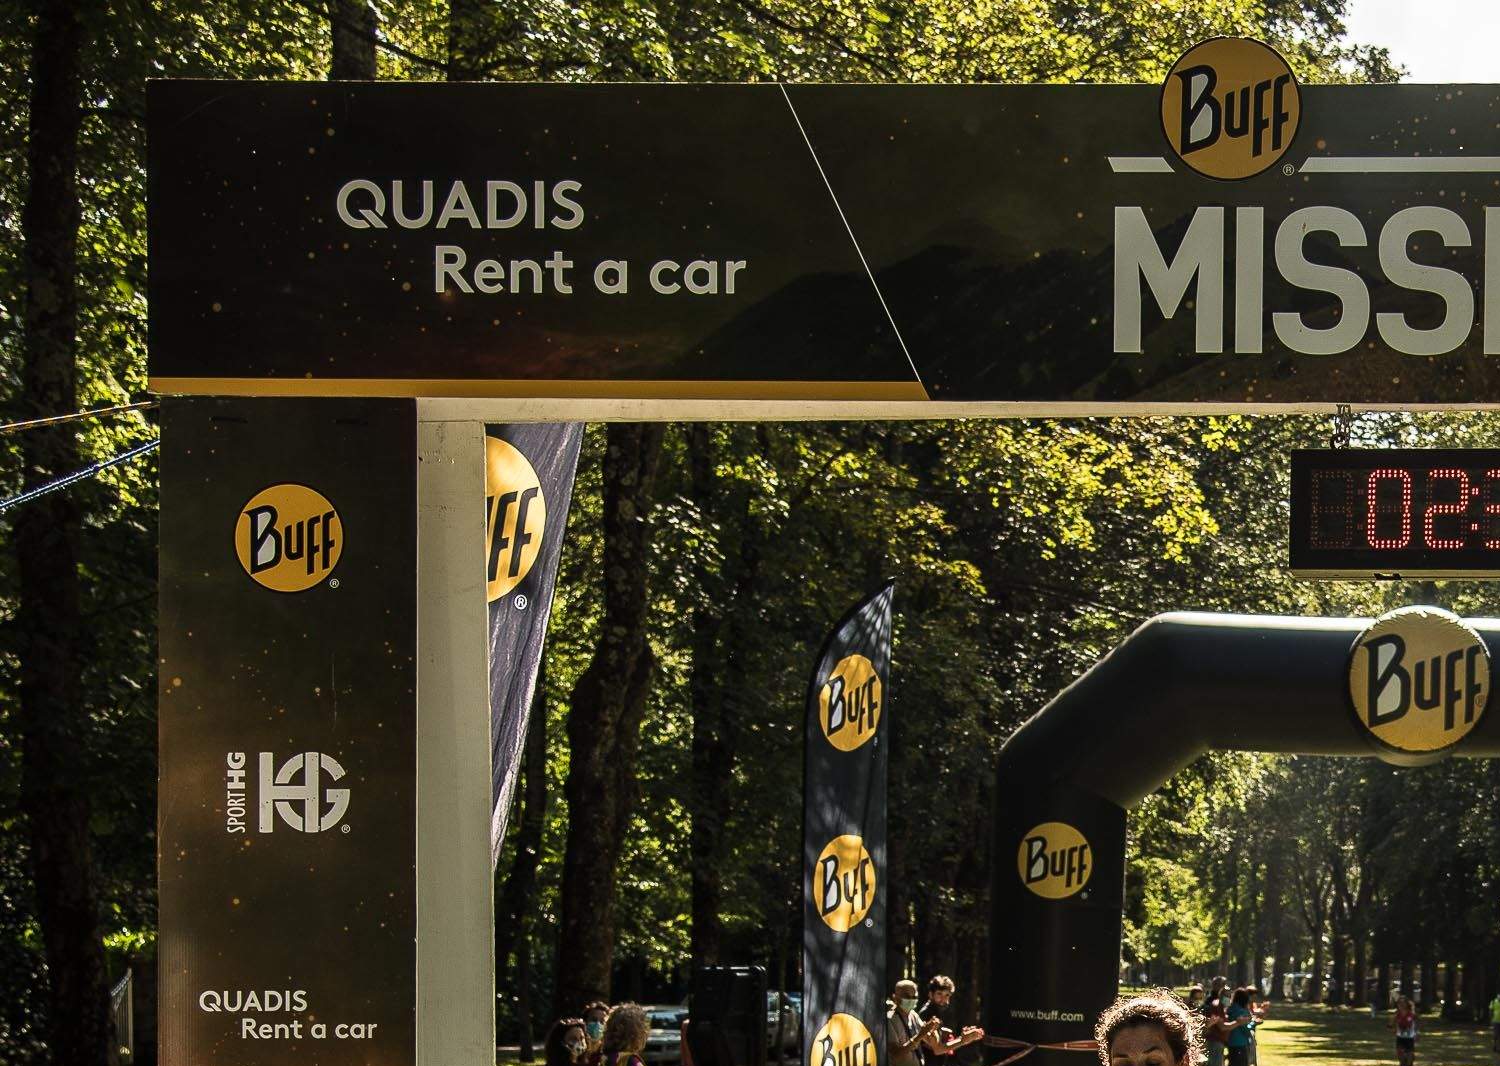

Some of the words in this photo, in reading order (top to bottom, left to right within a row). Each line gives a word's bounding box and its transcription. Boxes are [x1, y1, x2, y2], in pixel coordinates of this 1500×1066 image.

[335, 178, 586, 231] QUADIS
[434, 244, 574, 295] Rent
[593, 258, 630, 295] a
[649, 258, 747, 295] car
[485, 487, 539, 583] ff
[199, 990, 308, 1012] QUADIS
[1010, 1008, 1084, 1023] www.buff.com
[241, 1017, 303, 1040] Rent
[310, 1023, 327, 1039] a
[334, 1022, 378, 1039] car
